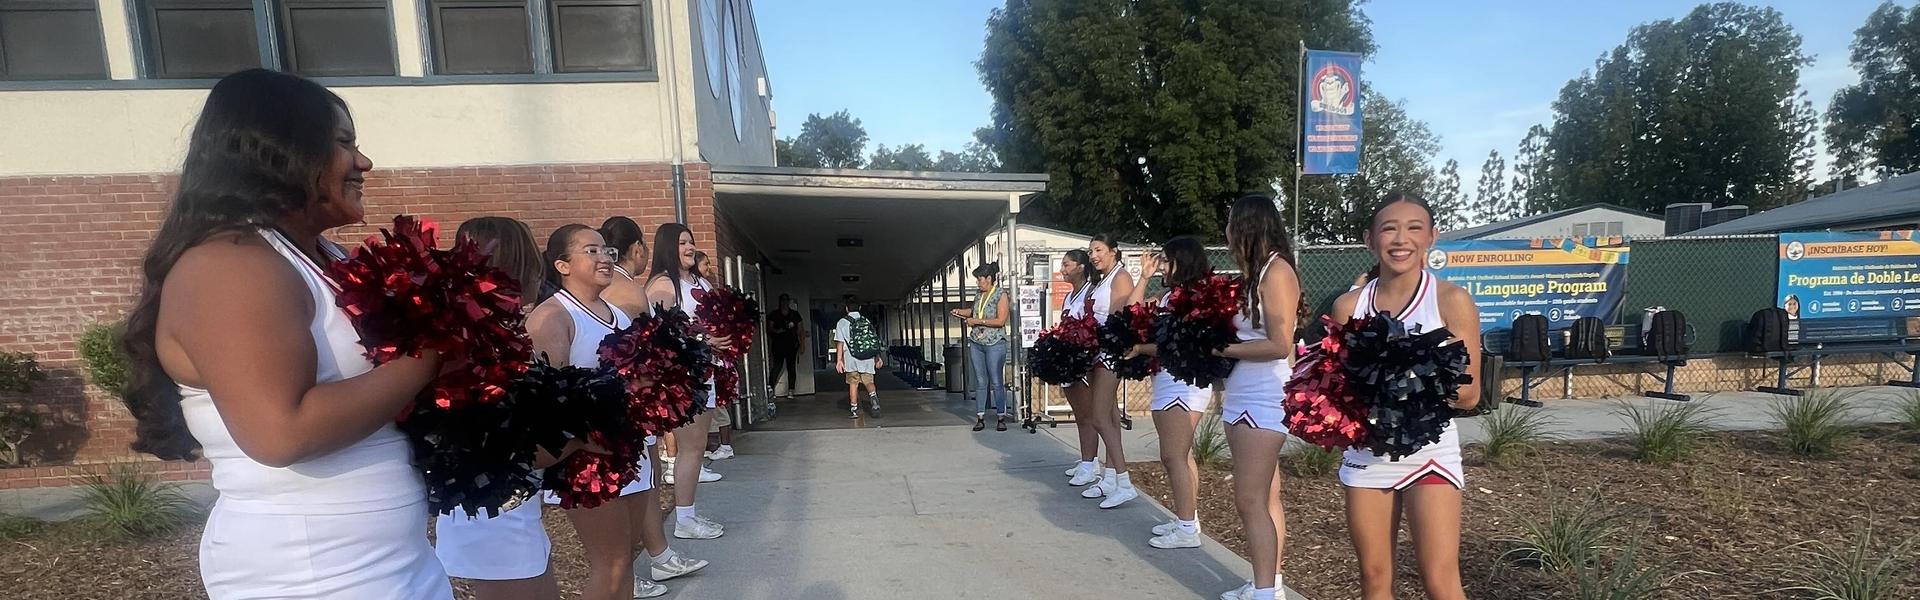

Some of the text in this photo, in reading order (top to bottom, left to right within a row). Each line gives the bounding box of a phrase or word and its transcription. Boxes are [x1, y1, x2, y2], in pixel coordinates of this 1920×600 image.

[1866, 244, 1889, 253] HOY!
[1451, 253, 1534, 264] NOW ENROLLING!
[1788, 274, 1848, 288] Programa
[1850, 271, 1865, 285] de
[1867, 270, 1902, 284] Doble
[1475, 282, 1545, 298] Language
[1547, 280, 1607, 297] Program
[1811, 302, 1817, 311] 4
[1850, 301, 1856, 310] 2
[1894, 300, 1900, 308] 2
[1551, 311, 1558, 319] 2
